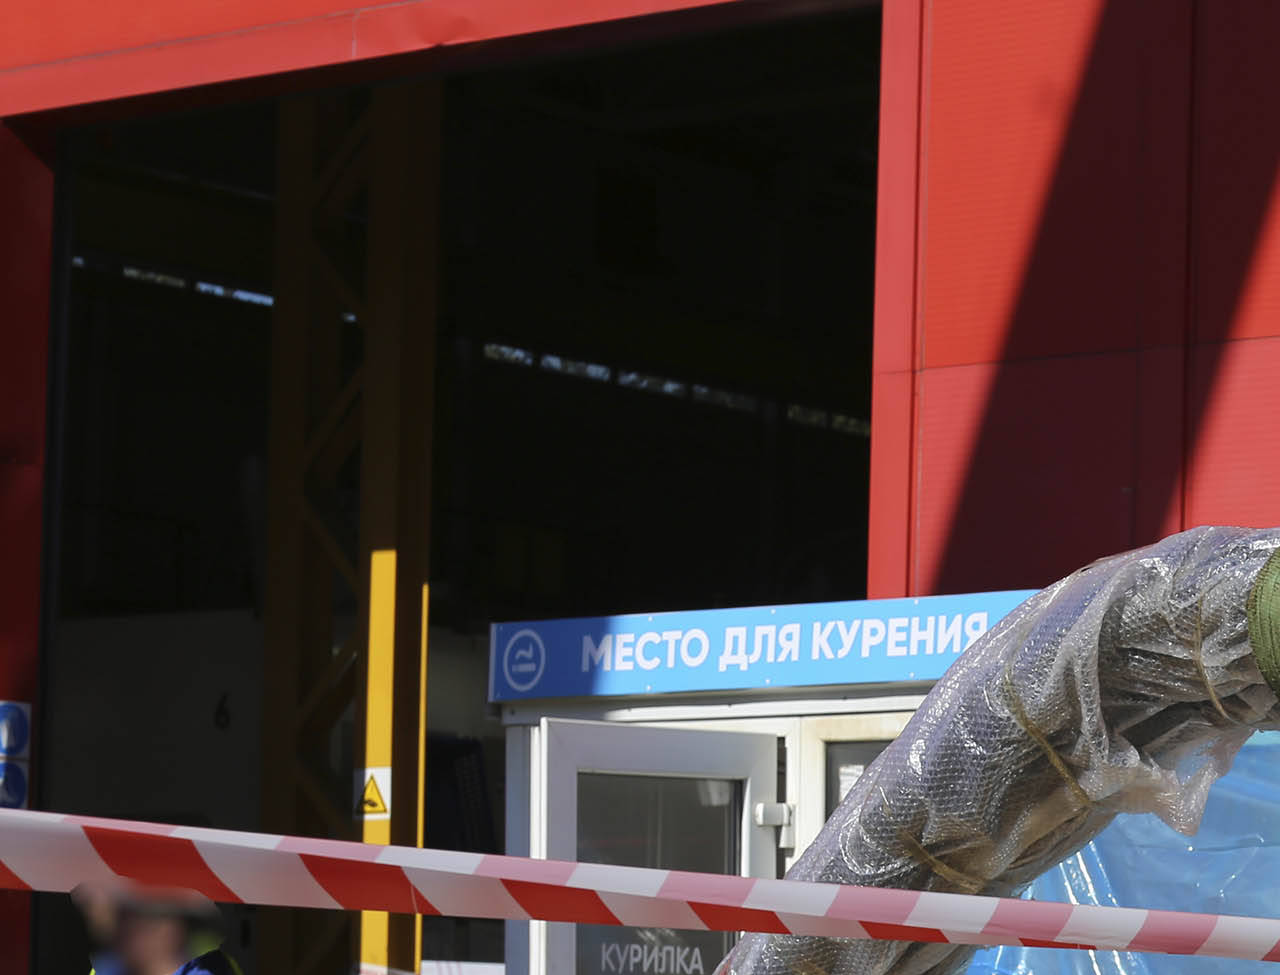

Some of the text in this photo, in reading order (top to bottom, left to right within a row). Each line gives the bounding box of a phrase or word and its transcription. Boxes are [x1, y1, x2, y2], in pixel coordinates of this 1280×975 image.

[581, 611, 990, 673] МЕСТО ДЛЯ КУРЕНИЯ
[600, 943, 705, 975] КУРИЛКА
